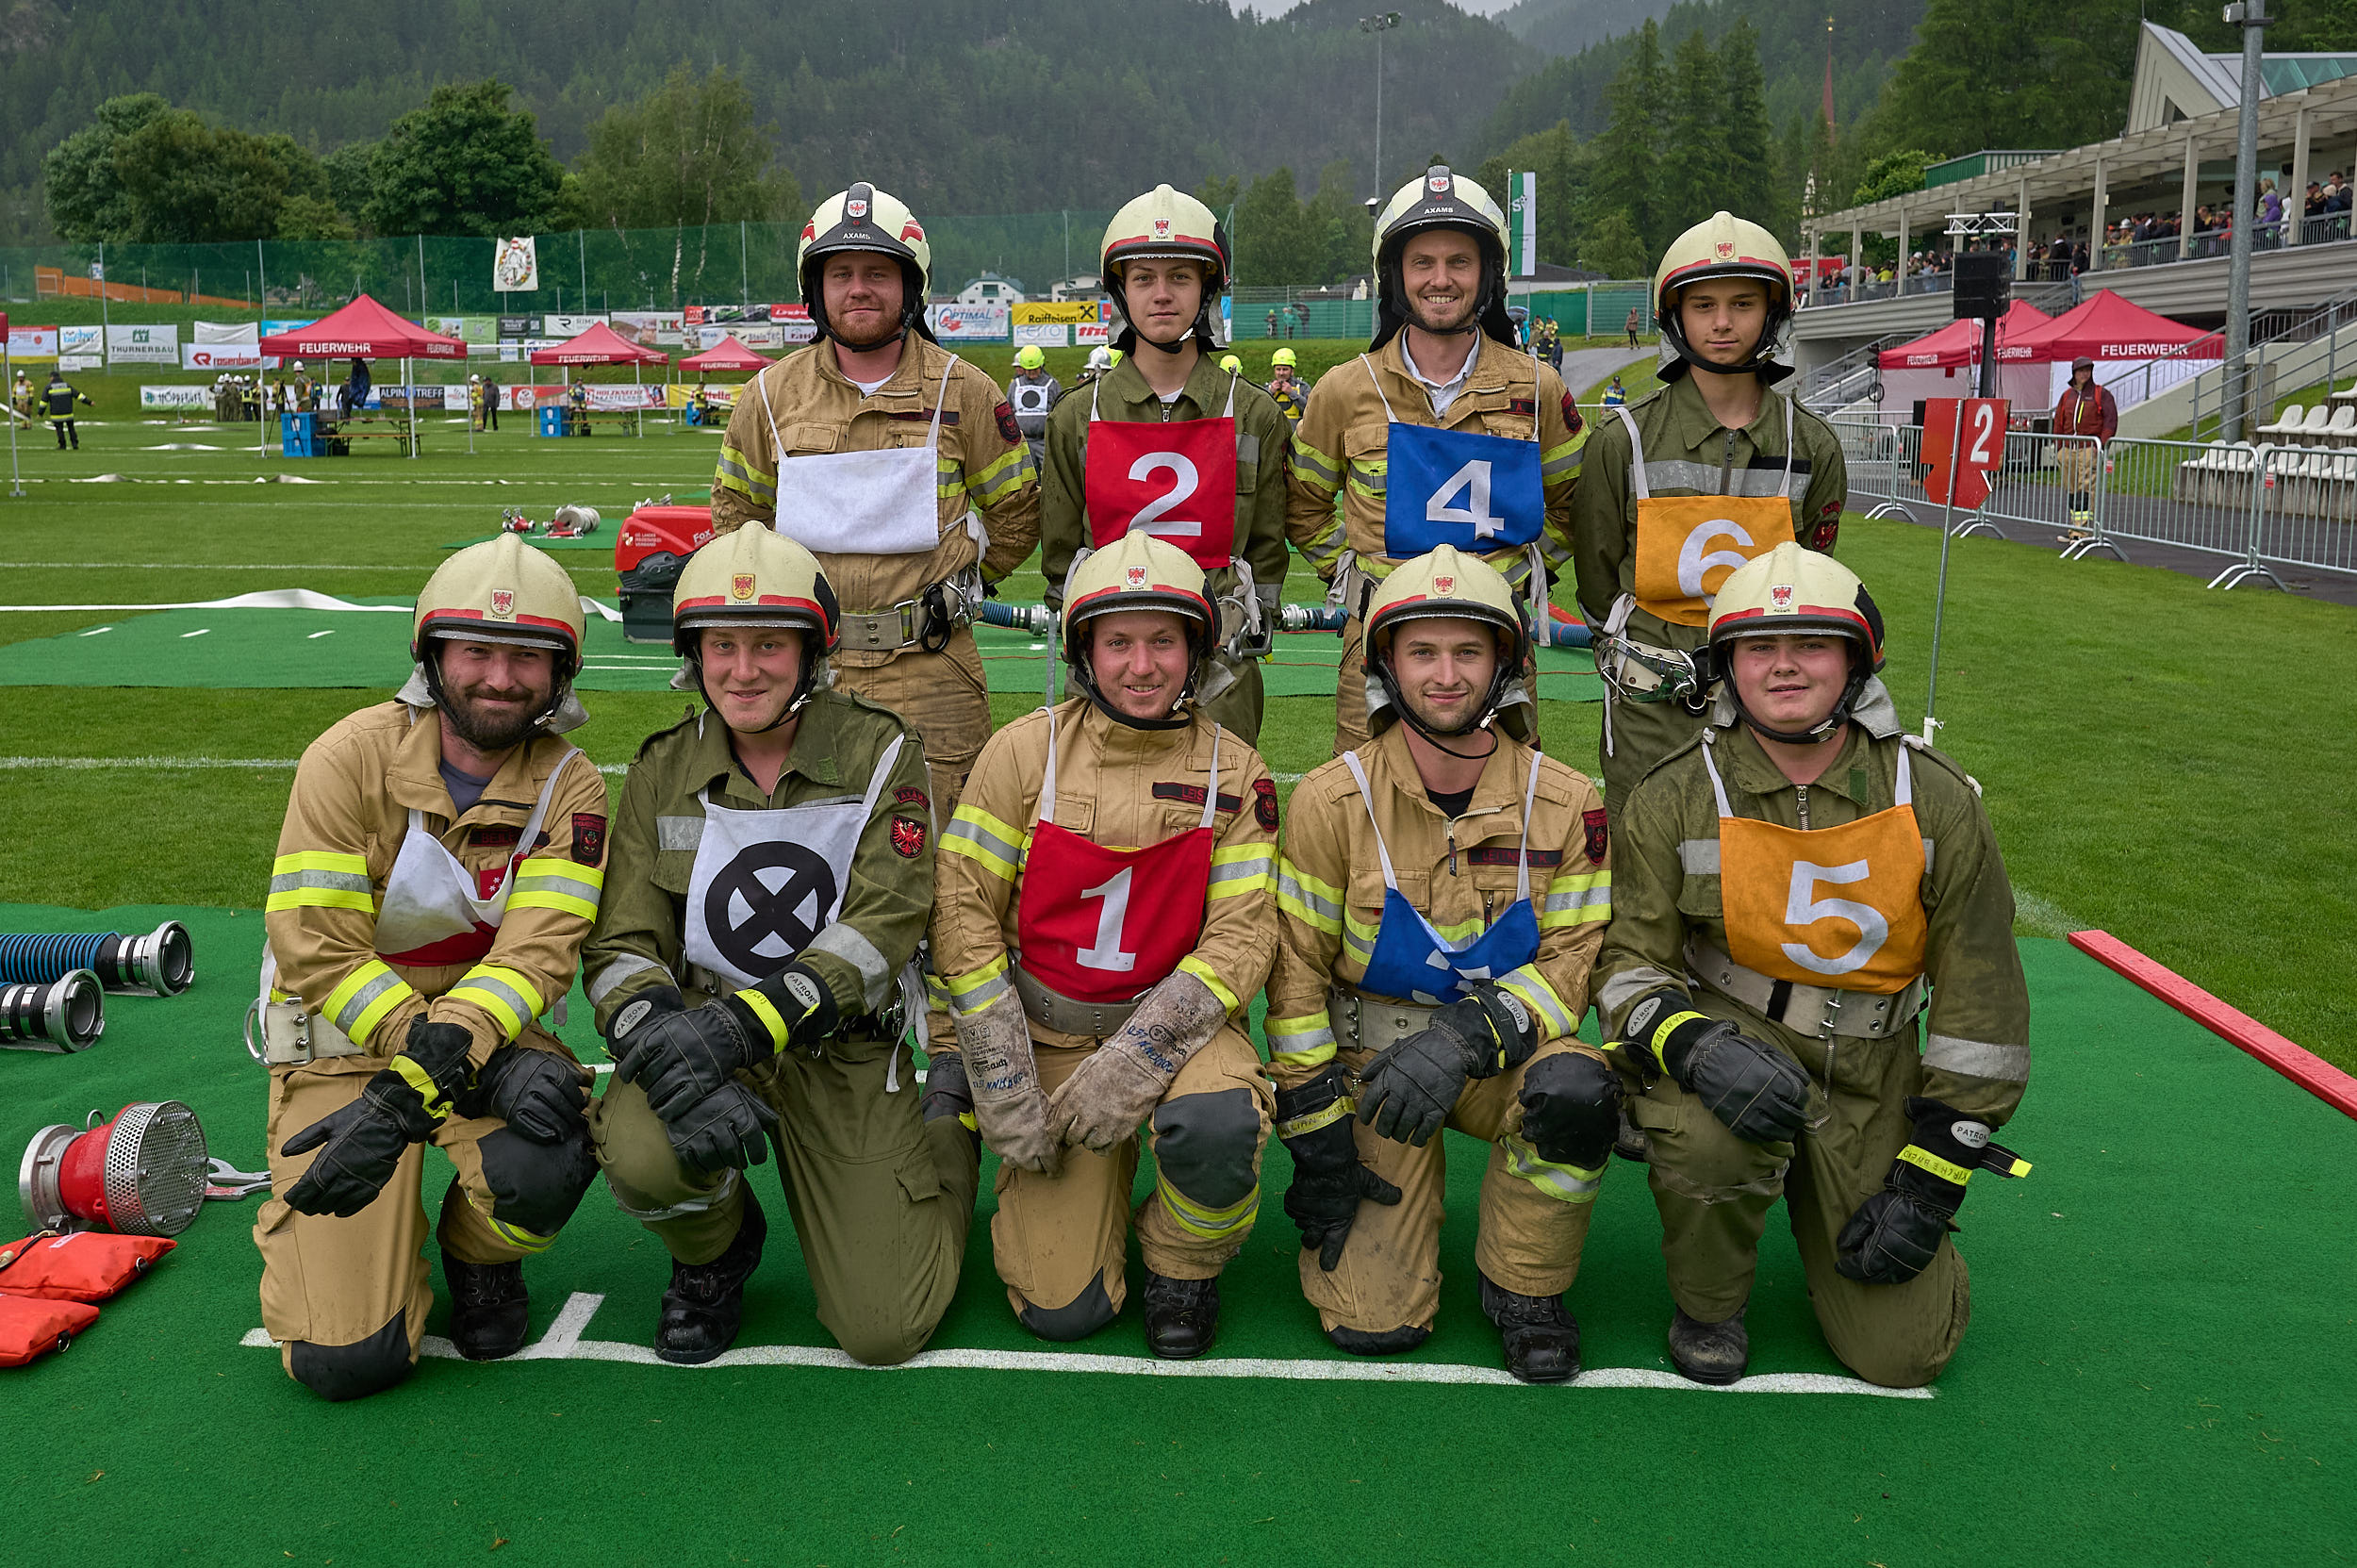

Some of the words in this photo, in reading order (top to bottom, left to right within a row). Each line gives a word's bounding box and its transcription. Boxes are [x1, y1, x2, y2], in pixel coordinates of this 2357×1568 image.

[1425, 206, 1454, 215] AXAMS
[938, 306, 993, 327] OPTIMAL
[1028, 314, 1077, 323] Raiffeisen
[299, 342, 371, 354] FEUERWEHR
[426, 343, 455, 355] FEUERWEHR
[1997, 346, 2032, 358] FEUERWEHR
[2101, 343, 2188, 357] FEUERWEHR
[213, 353, 261, 367] rosenbaue
[558, 355, 610, 363] FEUERWEHR
[1906, 354, 1938, 365] FEUERWEHR
[380, 388, 405, 398] ALPIN
[416, 388, 444, 398] TREFF
[1970, 404, 1994, 463] 2
[1128, 451, 1202, 536] 2
[1426, 459, 1505, 541] 4
[693, 529, 712, 543] Fox
[1677, 519, 1755, 609] 6
[1482, 850, 1534, 863] LEITNR
[1076, 866, 1137, 972] 1
[1780, 858, 1889, 975] 5
[787, 974, 816, 1003] PATRON
[1502, 993, 1525, 1027] PATRON
[1630, 1002, 1654, 1032] PATRON
[617, 1004, 643, 1033] PATRON
[1956, 1126, 1987, 1141] PATRON
